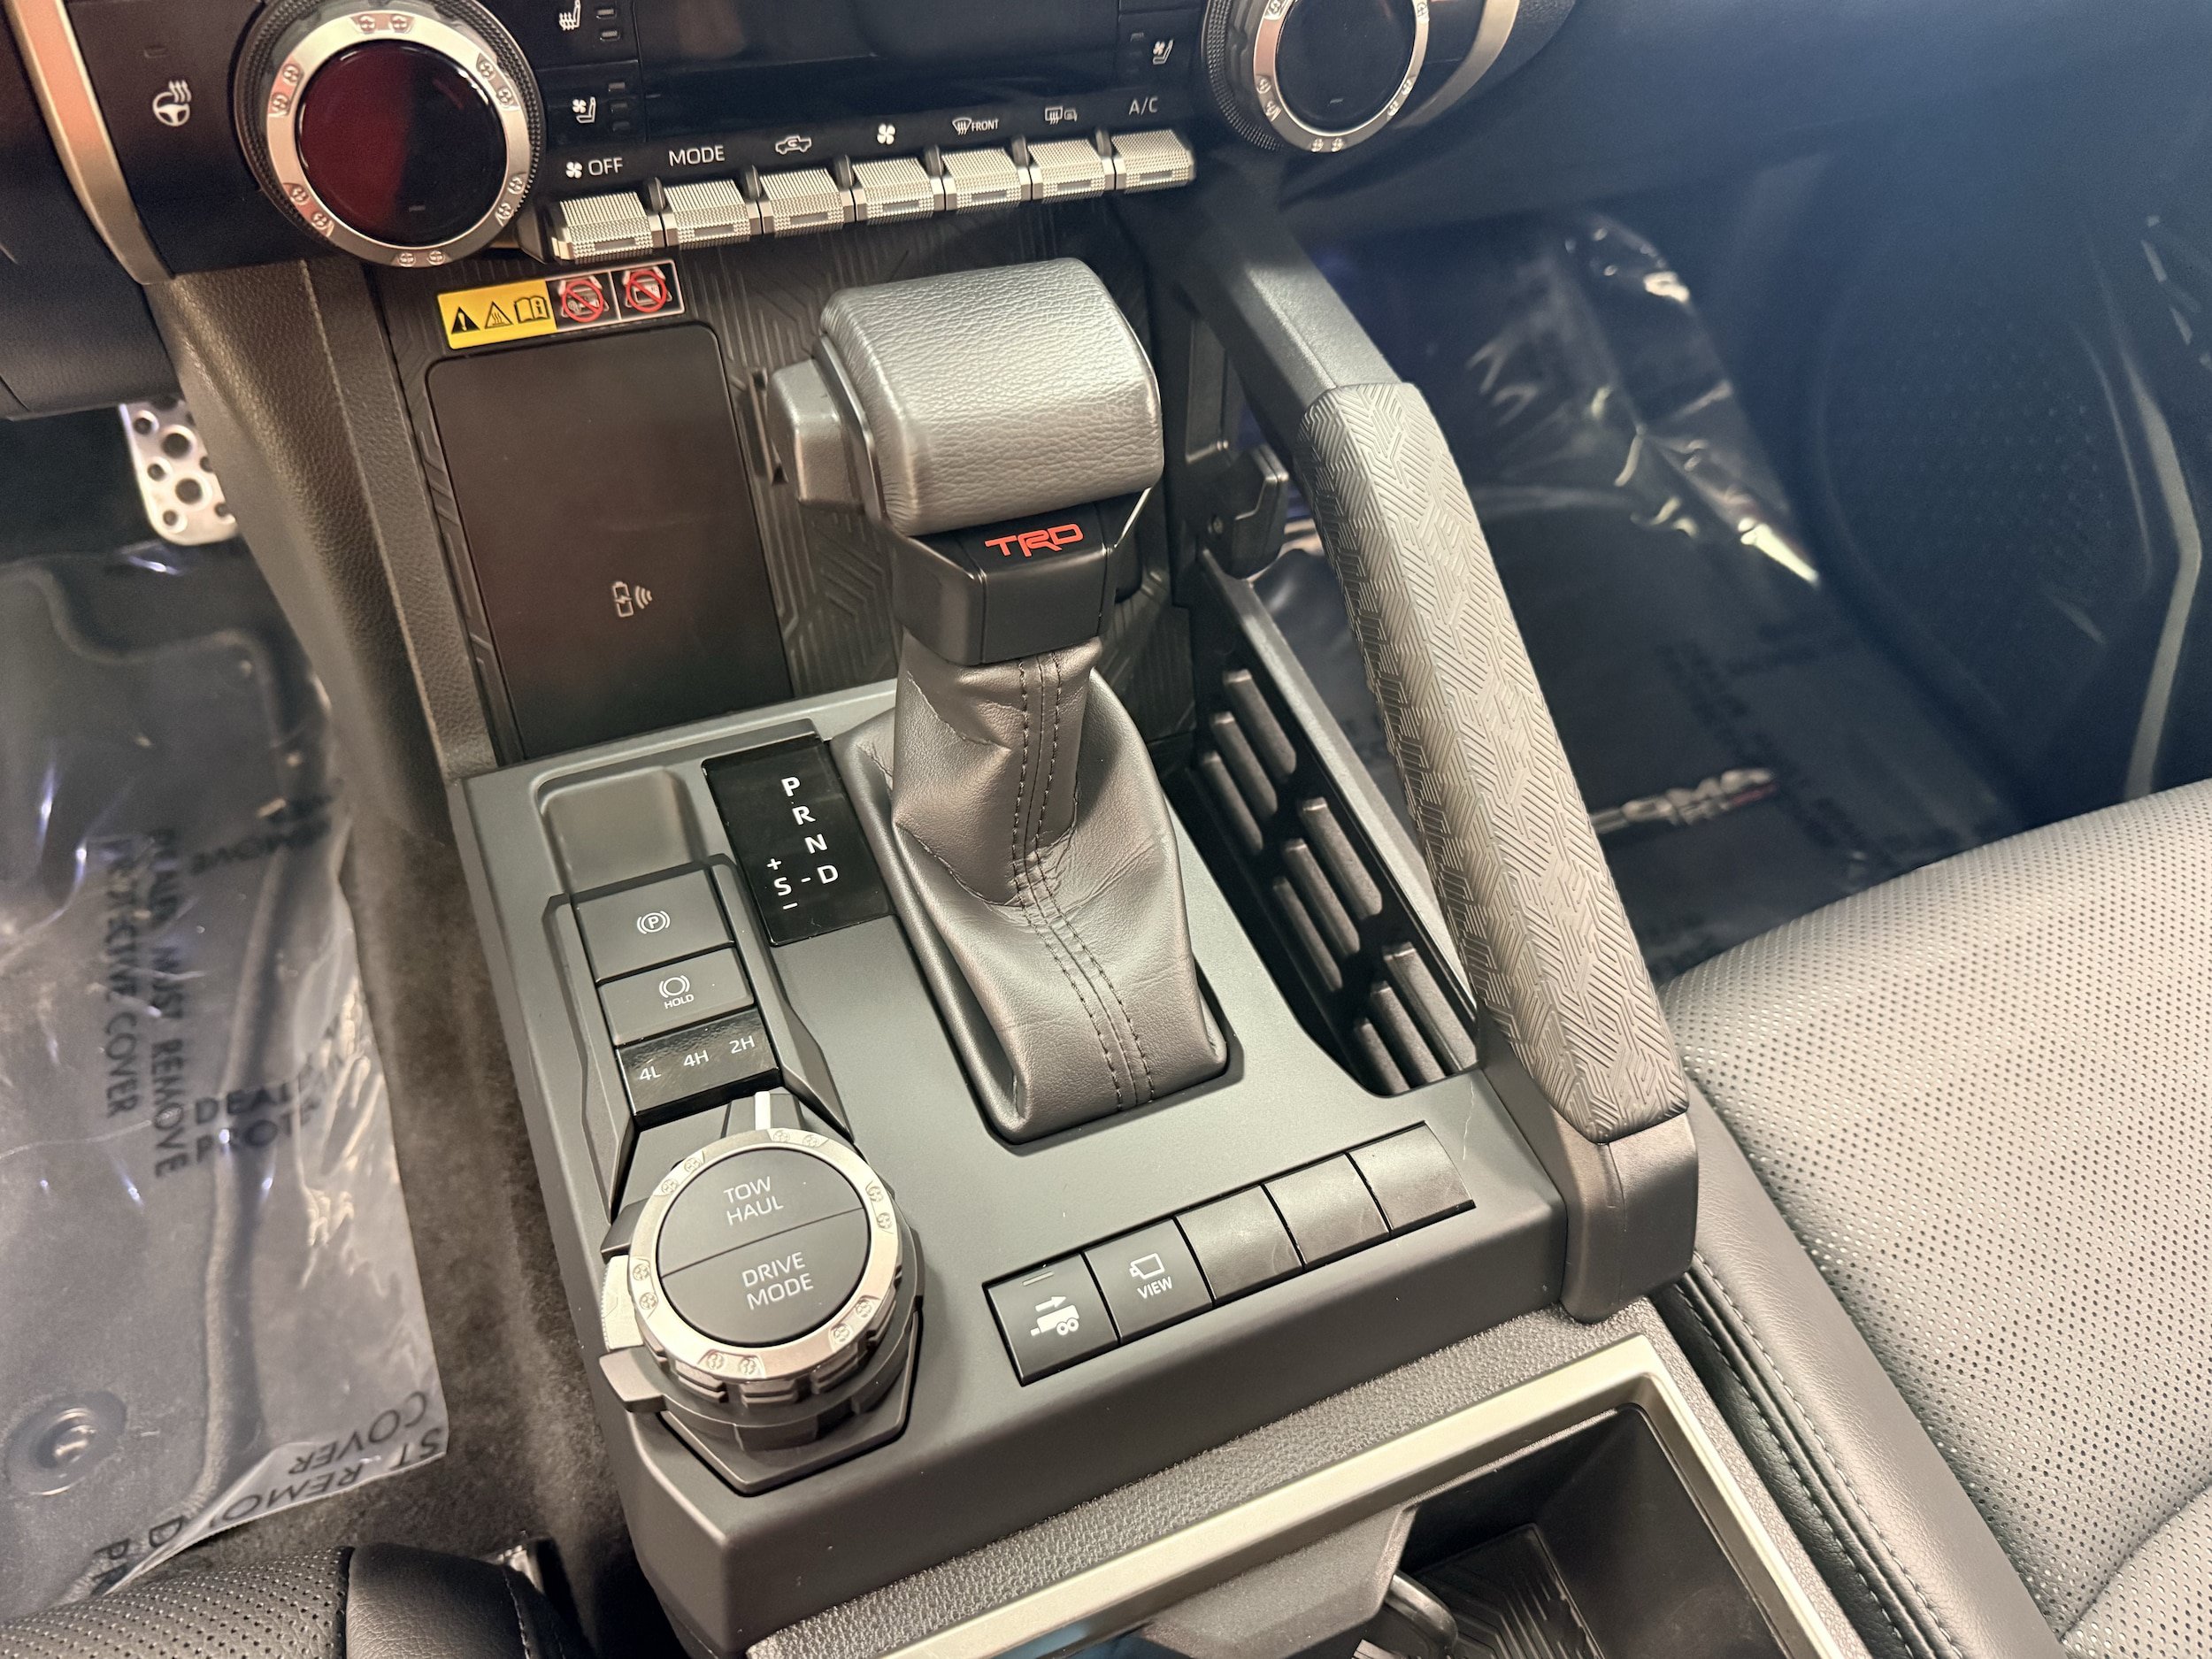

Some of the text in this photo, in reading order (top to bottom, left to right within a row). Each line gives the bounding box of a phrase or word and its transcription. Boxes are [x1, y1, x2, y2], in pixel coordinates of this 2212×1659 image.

[1128, 95, 1159, 115] A/C
[972, 119, 1000, 133] FRONT
[588, 157, 623, 177] OFF
[668, 145, 726, 167] MODE
[985, 523, 1084, 557] TRD
[781, 777, 800, 796] P
[792, 806, 816, 825] R
[804, 833, 827, 854] N
[774, 877, 792, 896] S
[817, 864, 839, 884] D
[664, 994, 695, 1010] HOLD
[104, 1012, 140, 1118] COVER
[639, 1035, 756, 1081] 4L 4H 2H
[150, 1039, 189, 1179] REMOVE
[724, 1176, 771, 1203] TOW
[726, 1196, 784, 1225] HAUL
[741, 1252, 806, 1287] DRIVE
[746, 1273, 814, 1311] MODE
[1137, 1276, 1173, 1299] VIEW
[288, 1391, 426, 1476] COVER
